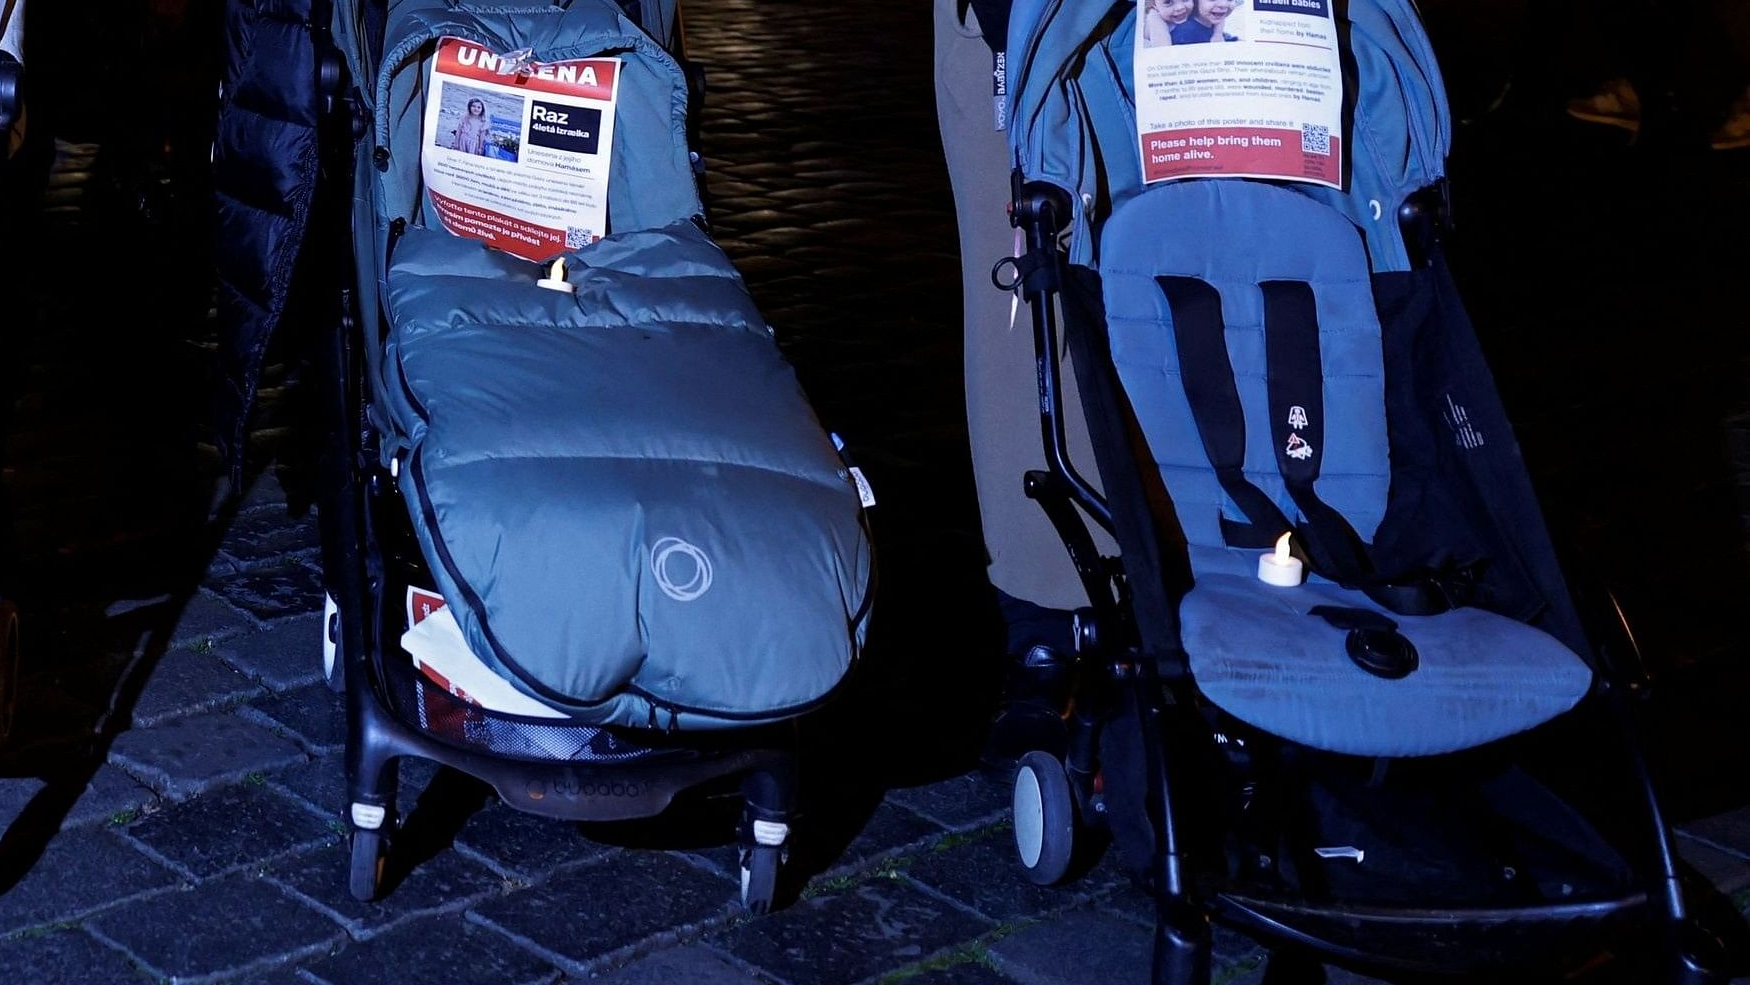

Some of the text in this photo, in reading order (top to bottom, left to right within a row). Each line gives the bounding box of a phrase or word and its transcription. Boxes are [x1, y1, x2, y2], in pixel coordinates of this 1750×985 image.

[532, 105, 569, 125] Raz
[1150, 135, 1282, 151] Please help bring them
[1151, 148, 1214, 164] home alive.
[464, 217, 502, 233] pomozte
